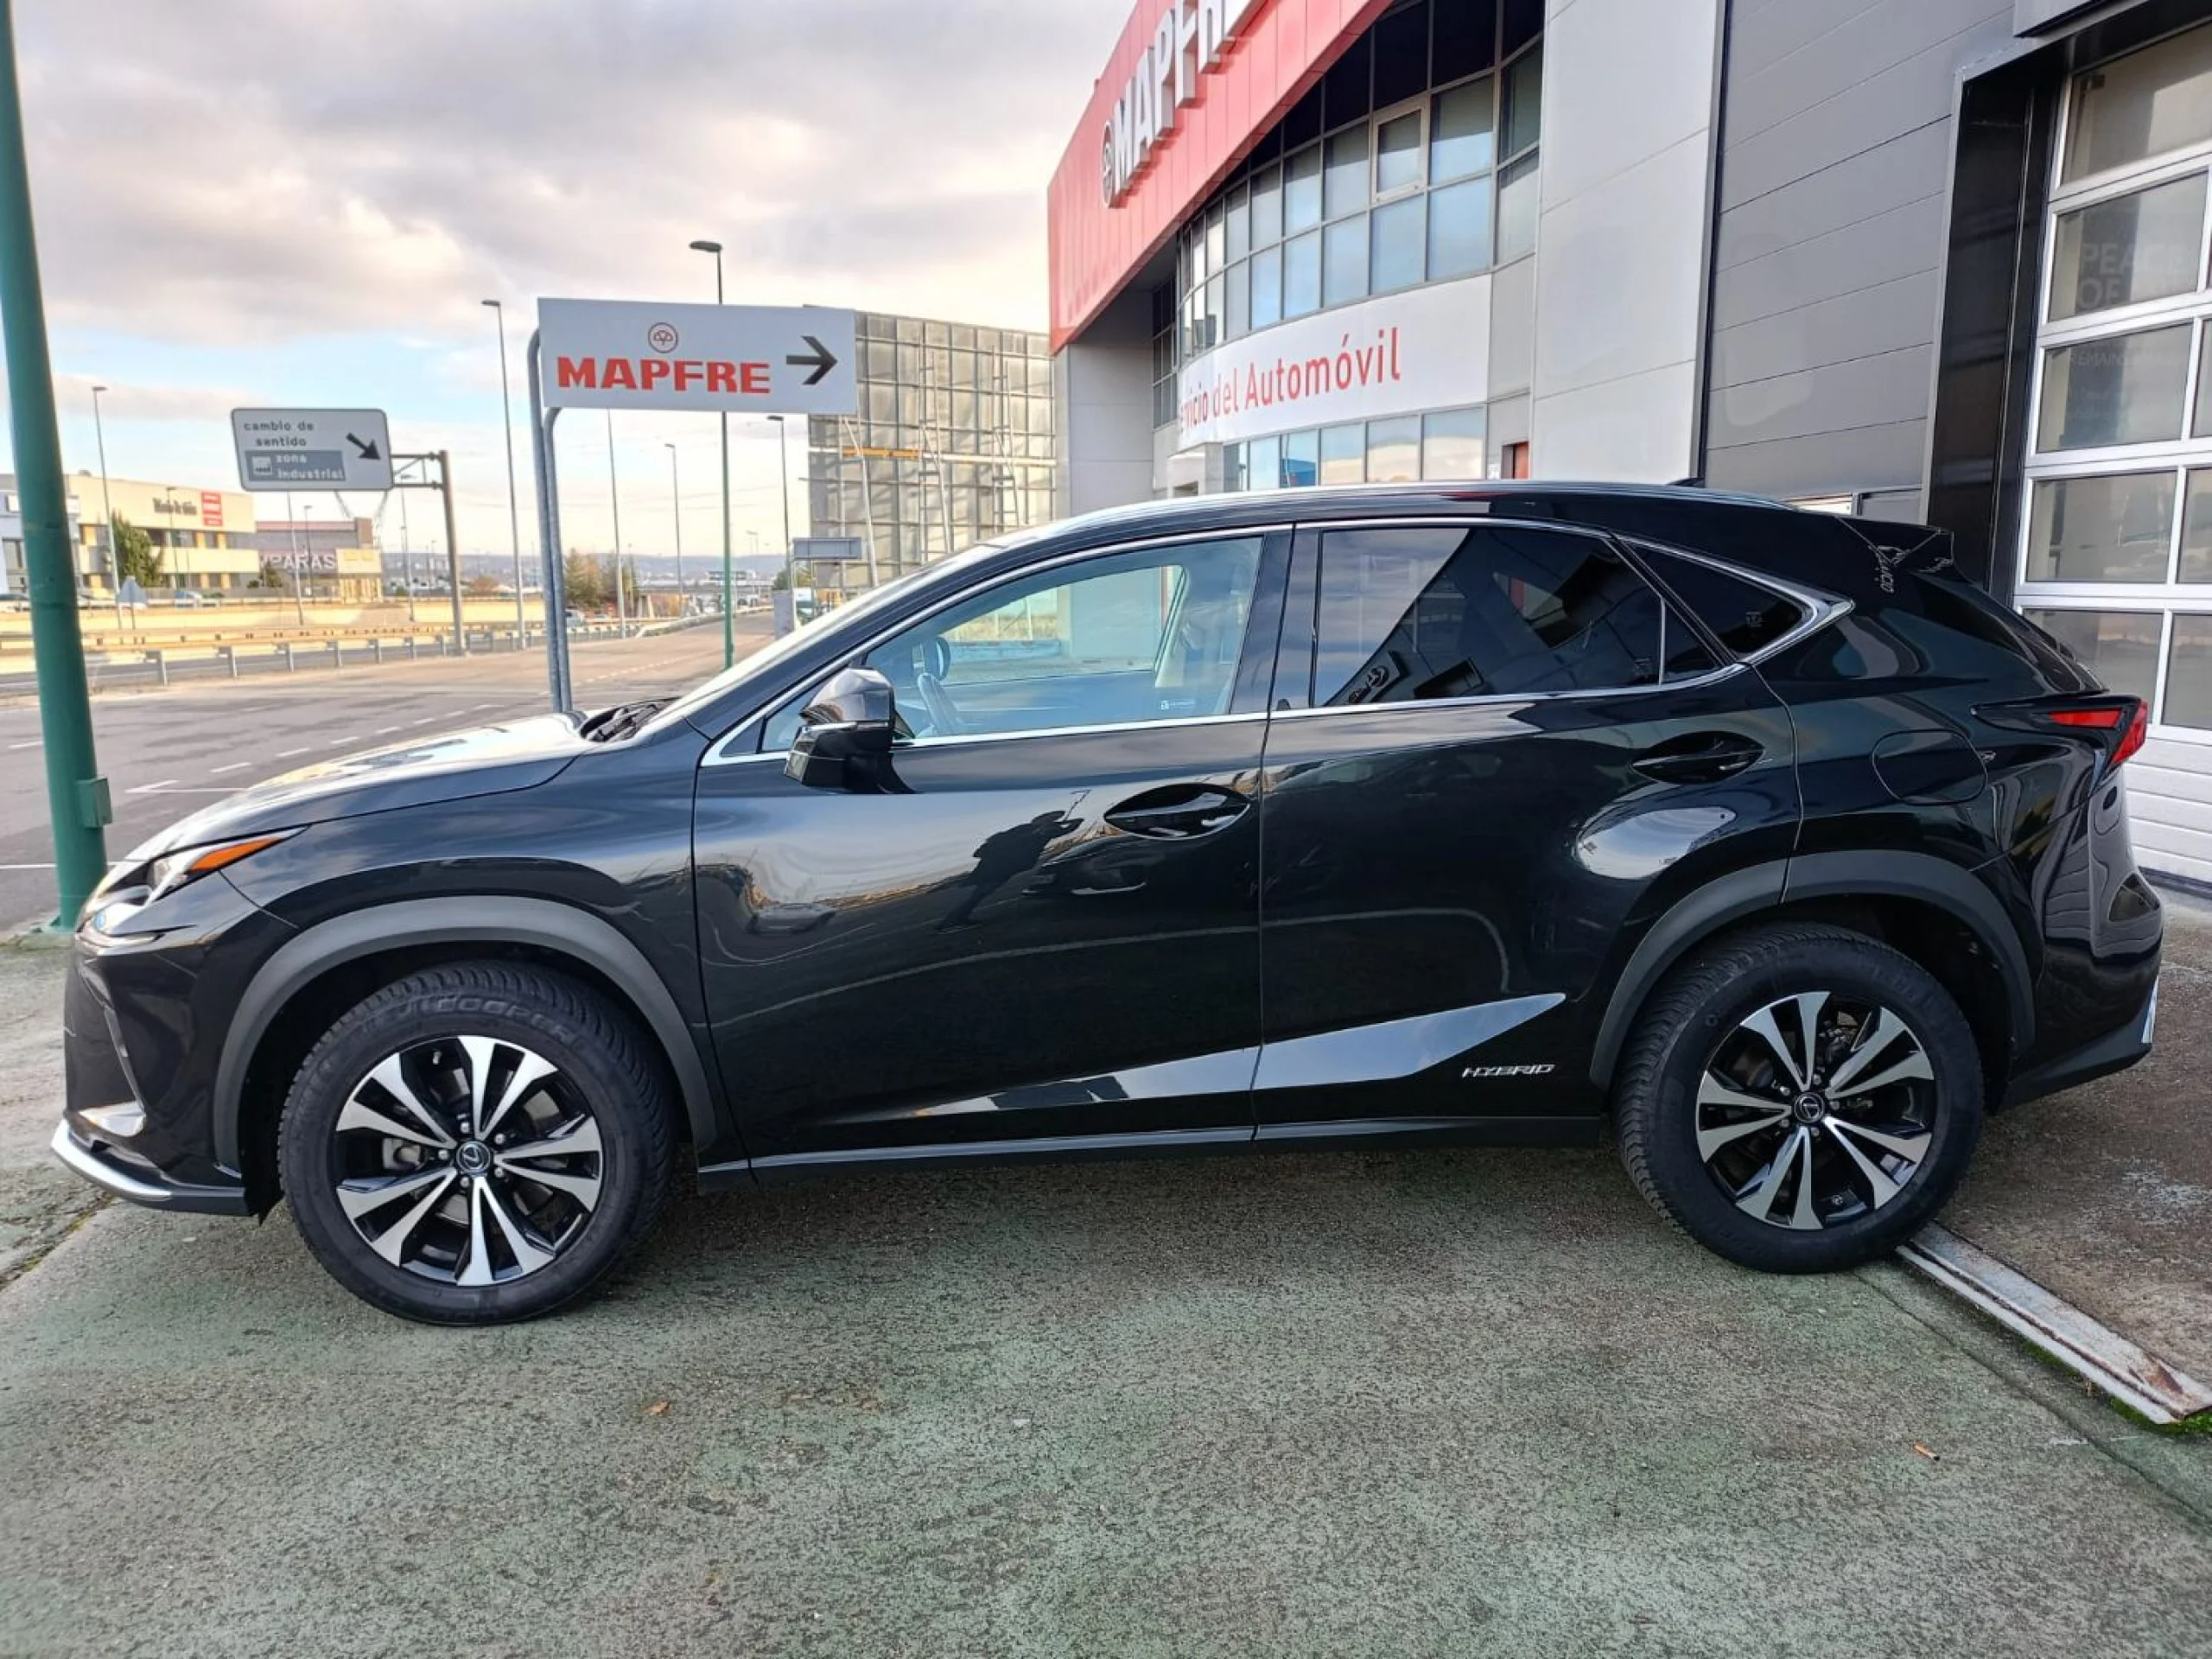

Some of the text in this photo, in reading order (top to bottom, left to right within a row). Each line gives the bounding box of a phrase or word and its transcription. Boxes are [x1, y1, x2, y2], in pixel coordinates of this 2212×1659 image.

[556, 356, 771, 394] MAPFRE
[1213, 367, 1238, 418] del
[1244, 327, 1401, 410] Automóvil
[244, 420, 315, 431] cambio de
[255, 435, 307, 447] sentido
[1461, 1064, 1555, 1077] HYBRID
